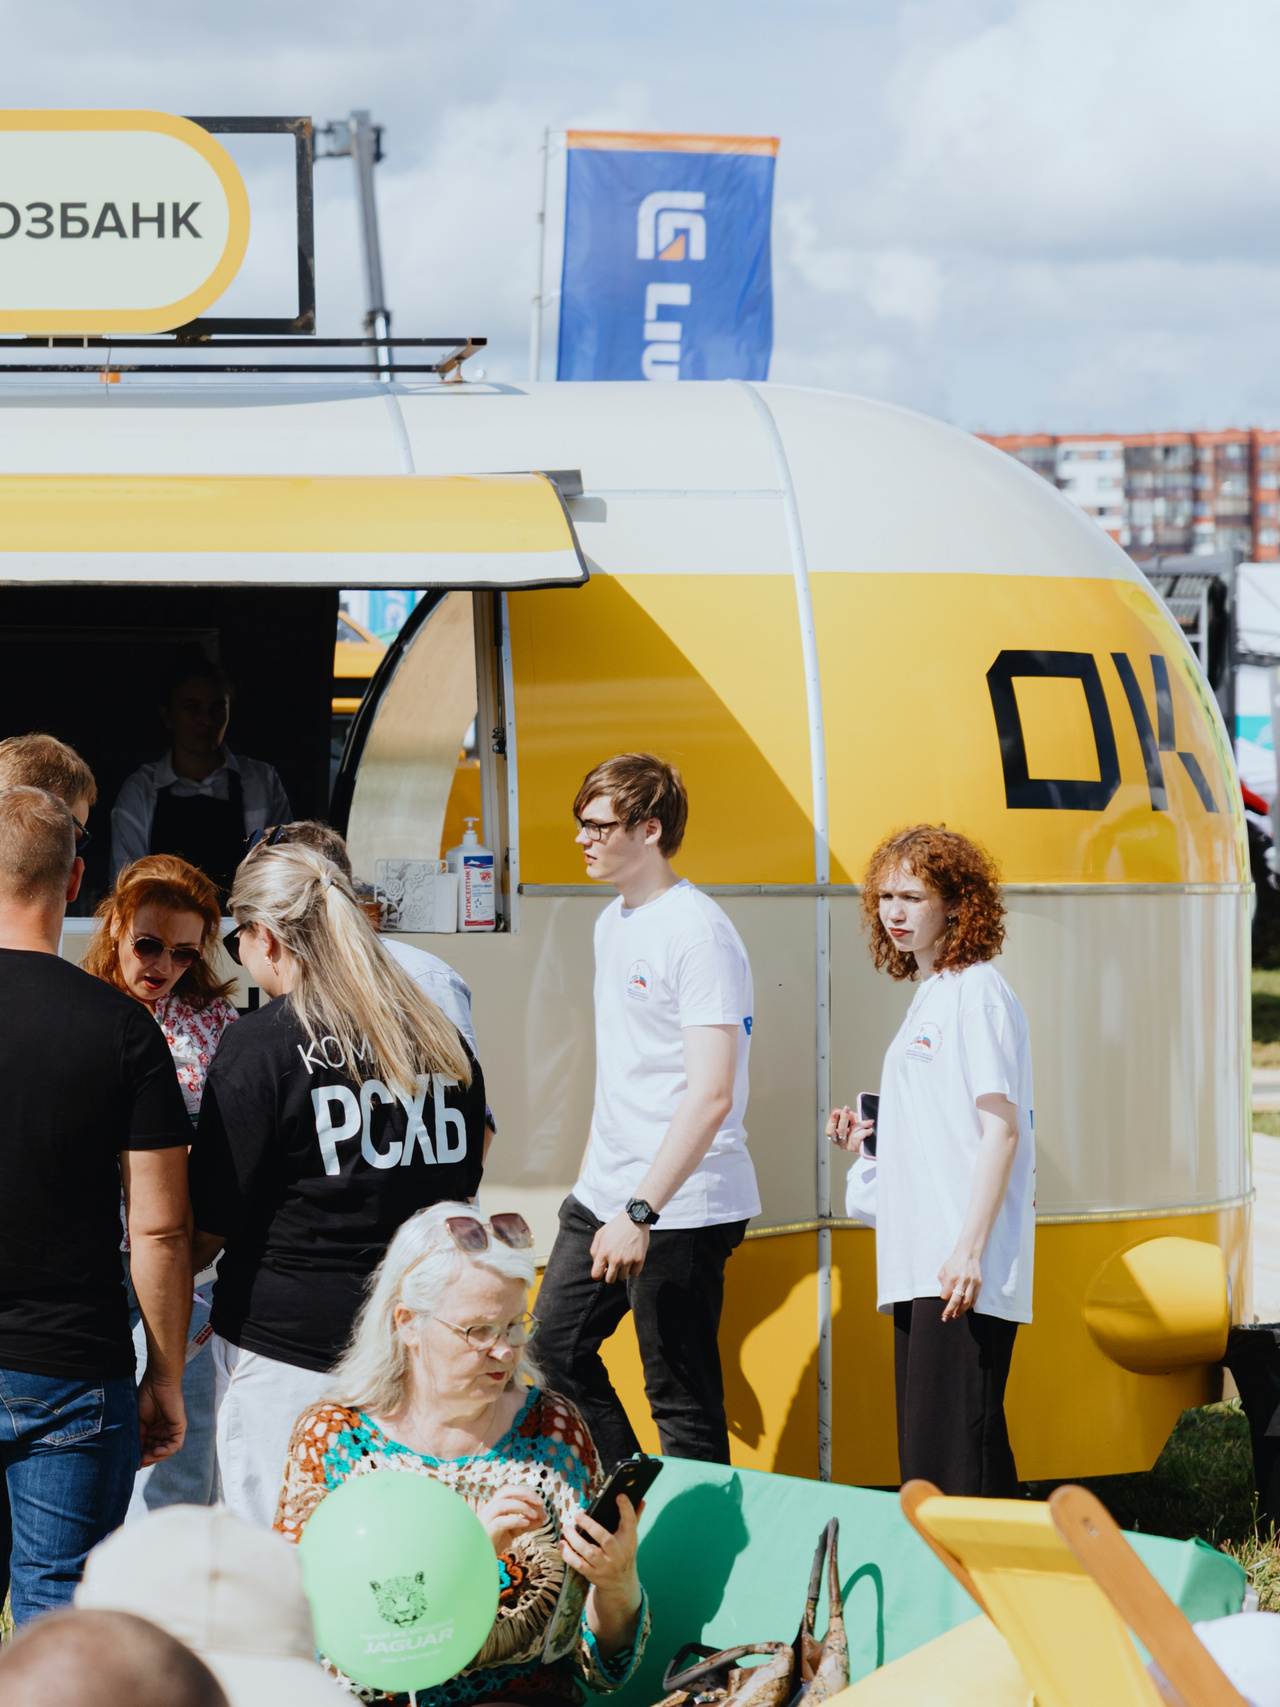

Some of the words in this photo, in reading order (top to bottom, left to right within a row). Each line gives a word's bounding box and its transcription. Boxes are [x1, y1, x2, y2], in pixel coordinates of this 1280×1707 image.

[464, 870, 472, 919] АНТИСЕПТИК
[310, 1072, 468, 1176] РСХБ
[362, 1627, 455, 1654] JAGUAR
